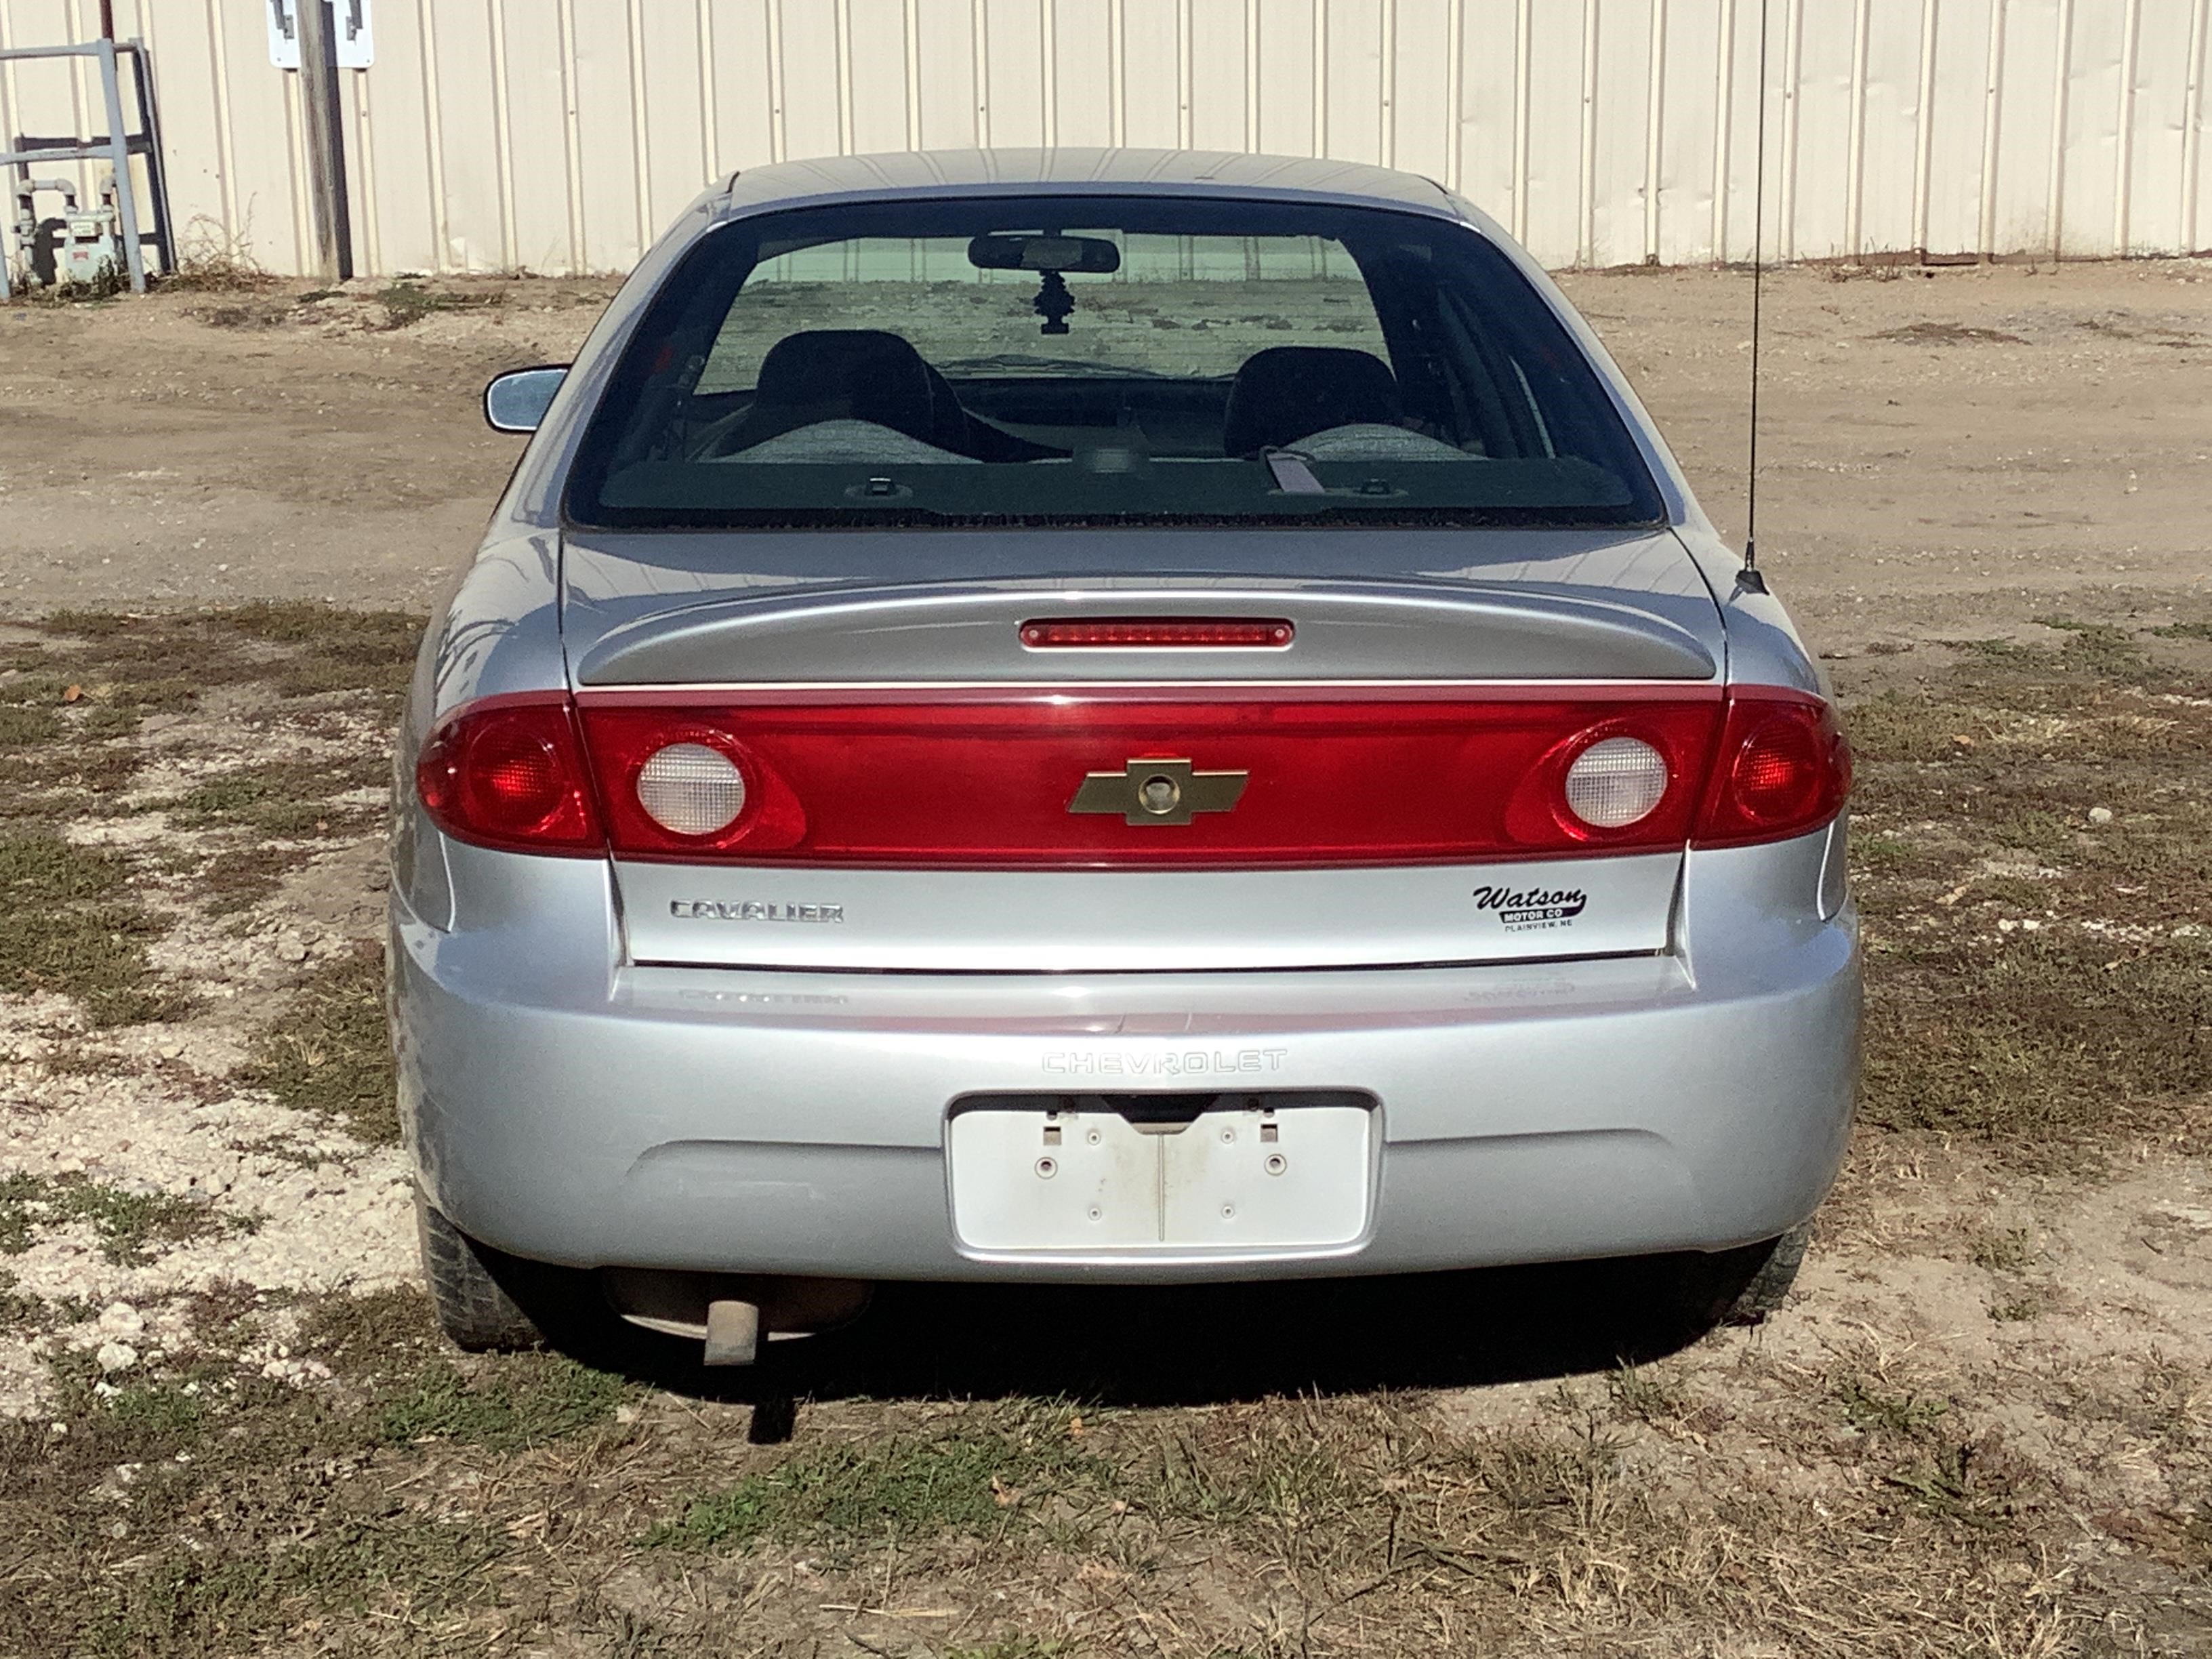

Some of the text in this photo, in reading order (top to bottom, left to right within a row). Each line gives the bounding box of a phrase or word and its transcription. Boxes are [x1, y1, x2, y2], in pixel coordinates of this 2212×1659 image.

[1473, 886, 1587, 909] Watson
[670, 899, 844, 922] CAVALIER
[1504, 908, 1563, 922] MOTOR CO
[1560, 919, 1573, 927] NE
[1042, 1048, 1288, 1076] CHEVROLET
